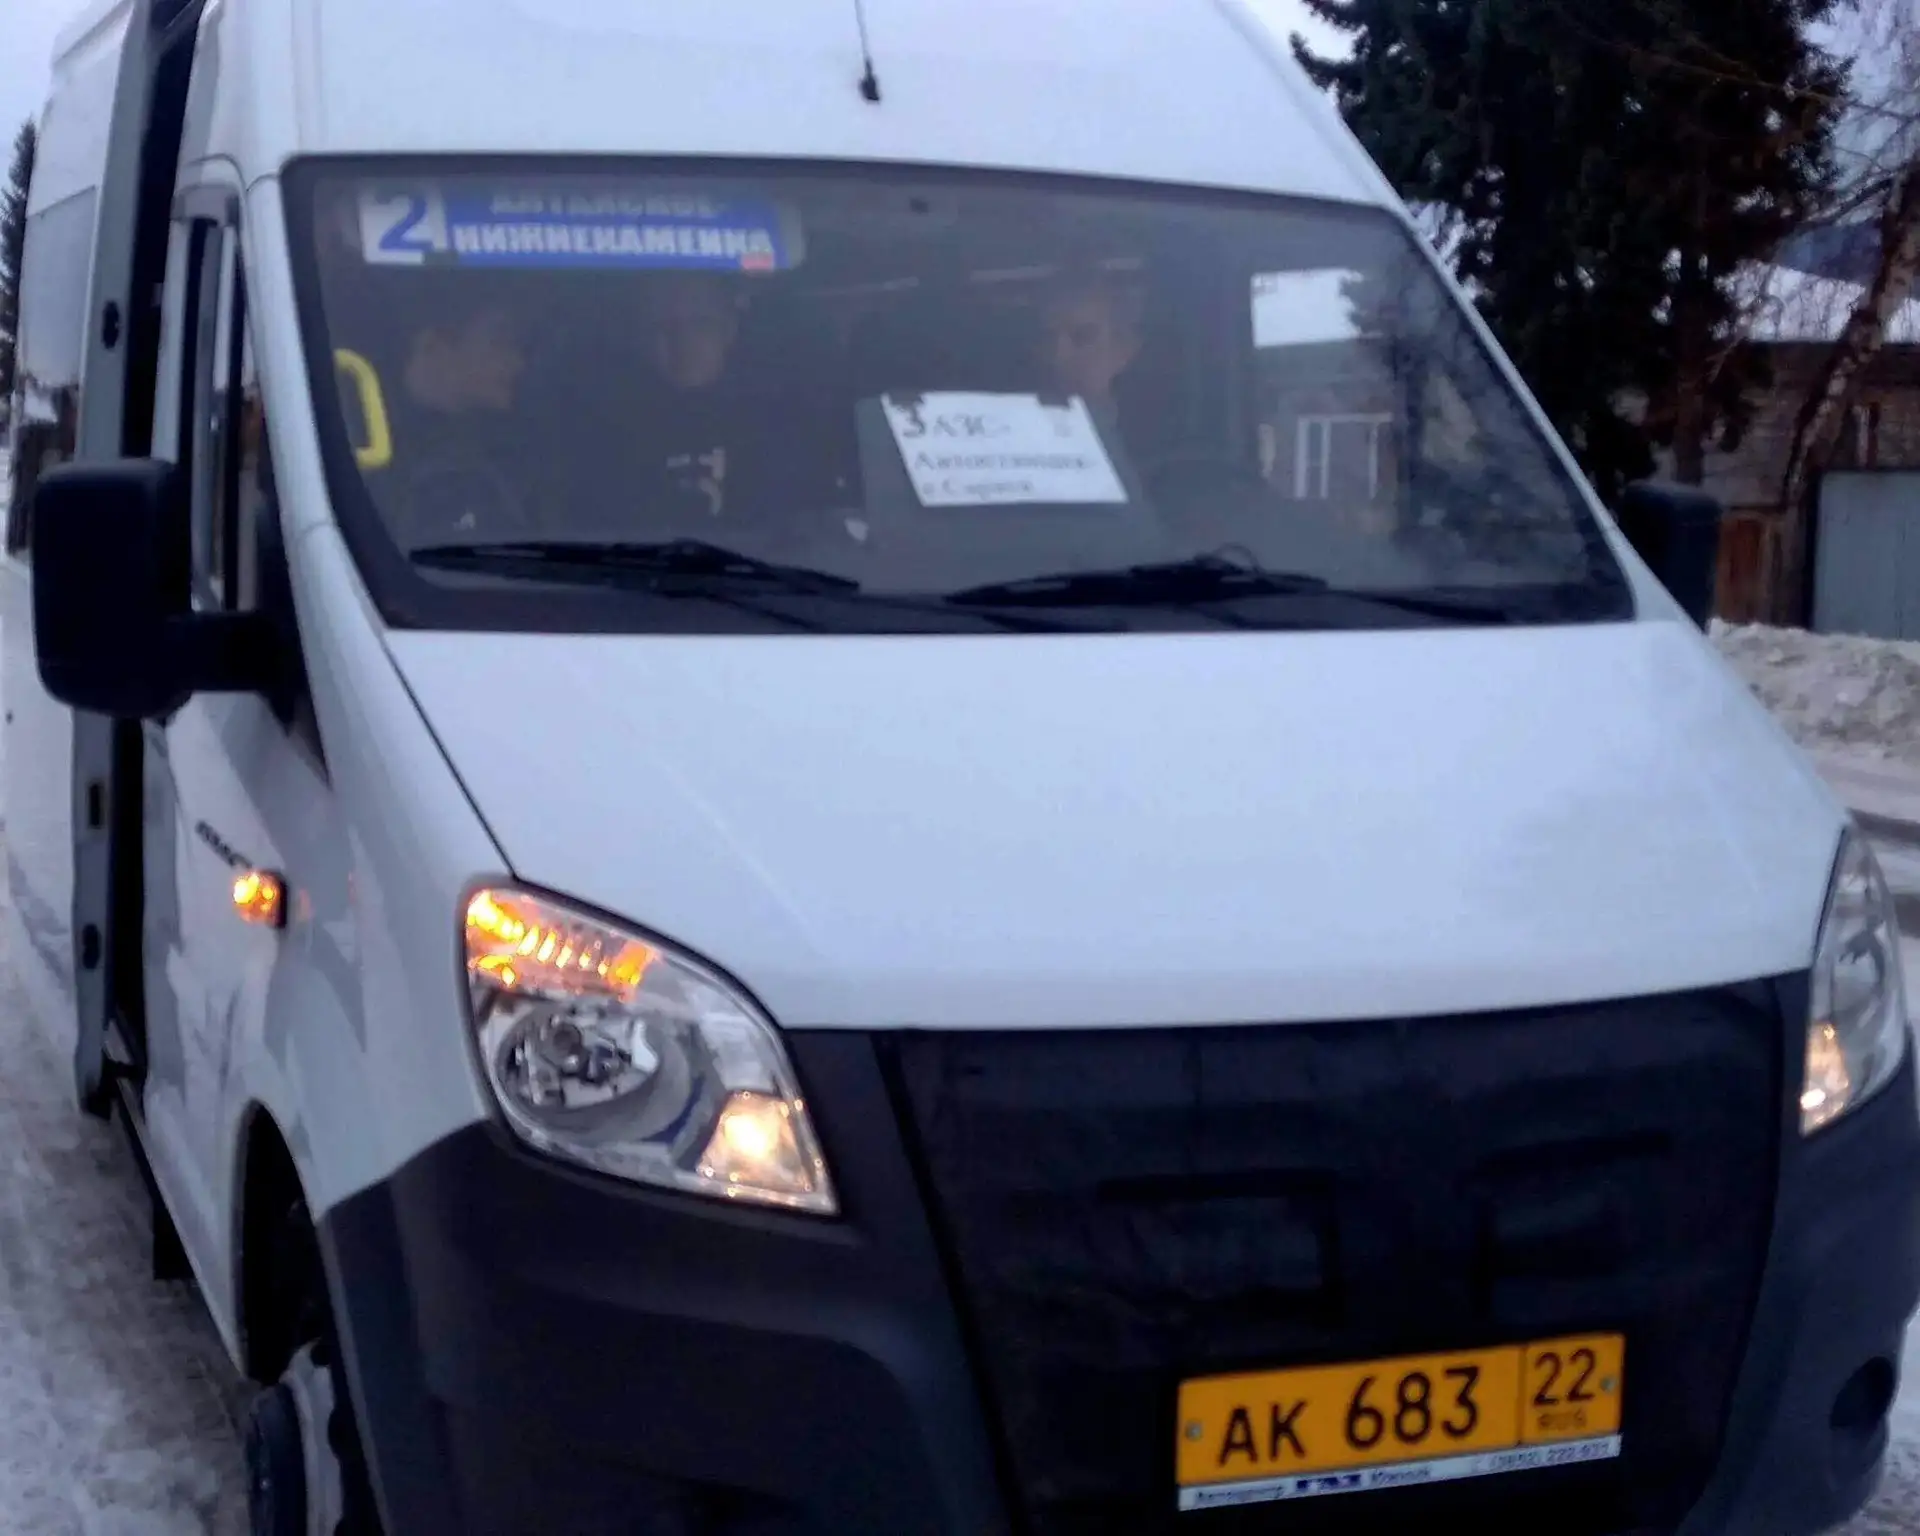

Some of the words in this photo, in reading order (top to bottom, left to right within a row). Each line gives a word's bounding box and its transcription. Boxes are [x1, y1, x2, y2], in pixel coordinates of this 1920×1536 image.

[453, 222, 773, 256] НИЖНЕКАМЕНКА
[1219, 1400, 1306, 1466] АК
[1345, 1366, 1480, 1451] 683
[1533, 1347, 1597, 1407] 22
